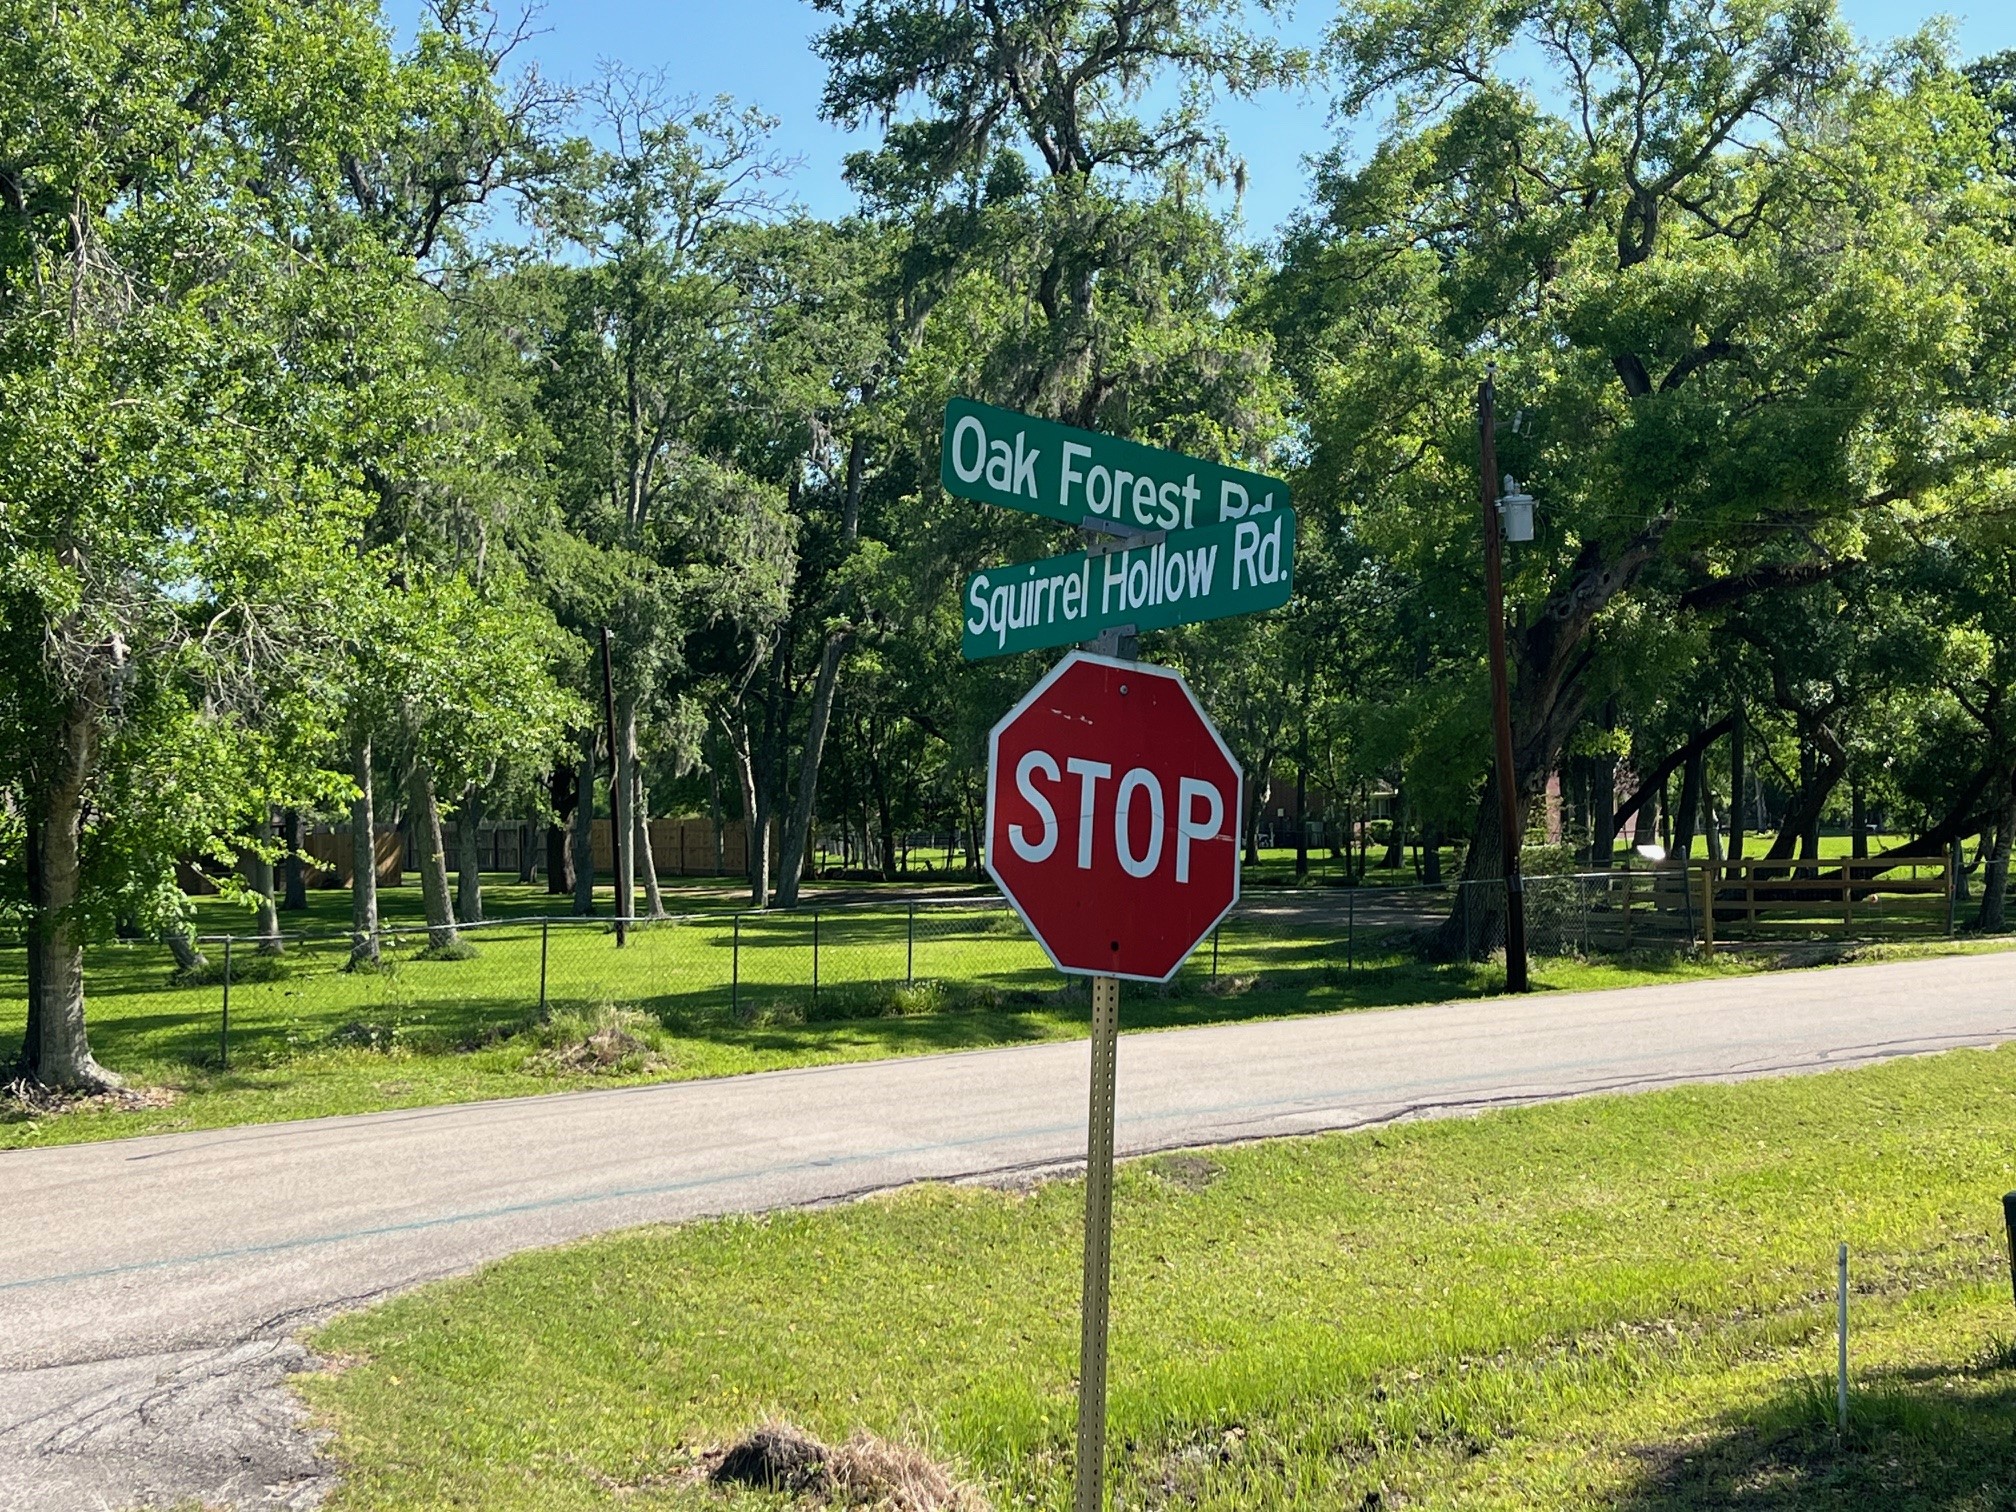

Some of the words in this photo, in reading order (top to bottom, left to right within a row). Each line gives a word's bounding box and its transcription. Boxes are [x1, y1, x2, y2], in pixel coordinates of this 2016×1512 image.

[952, 415, 1040, 499] Oak
[1060, 440, 1201, 530] Forest
[967, 558, 1090, 650] Squirrel
[1102, 542, 1218, 614] Hollow
[1232, 515, 1288, 590] Rd.
[1008, 750, 1224, 884] STOP
